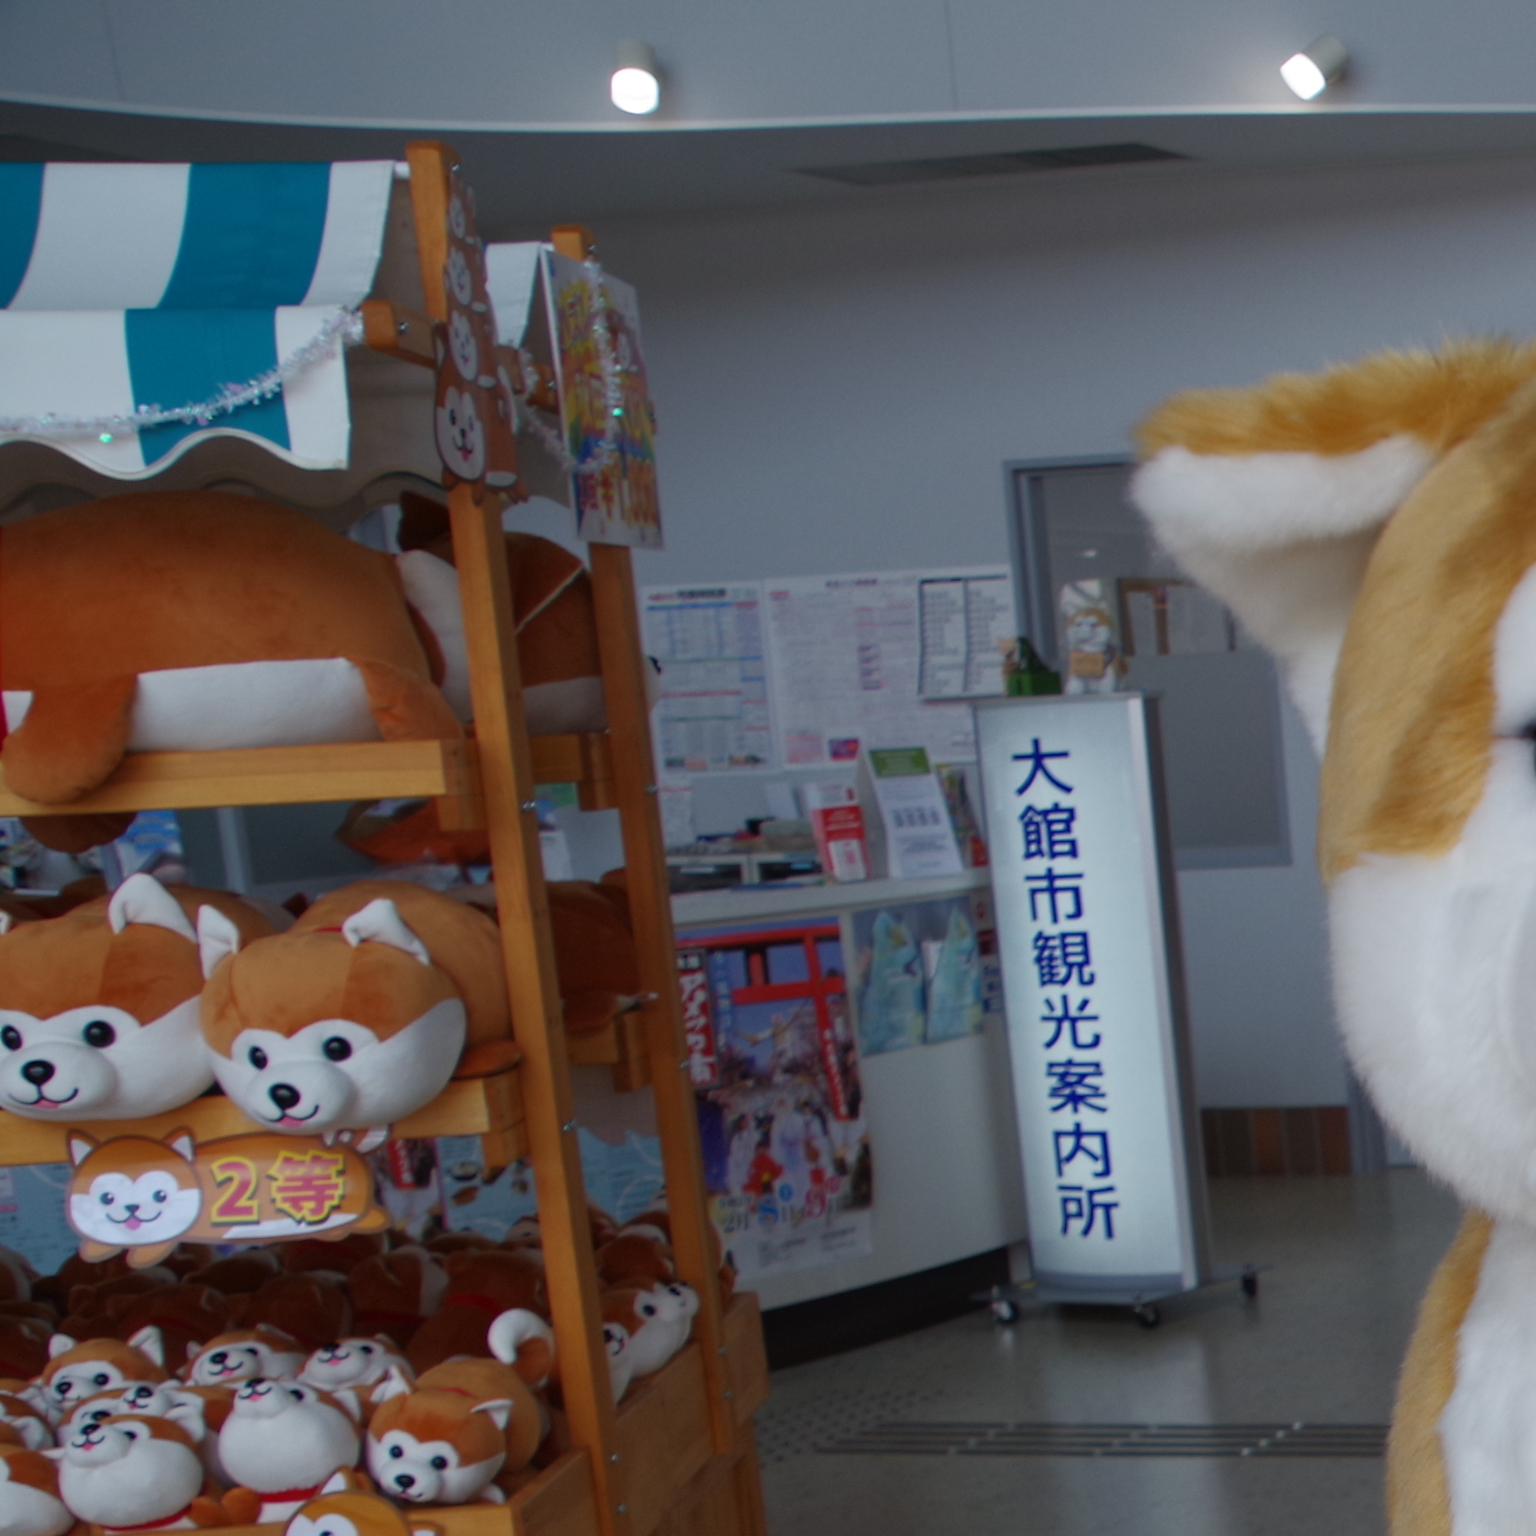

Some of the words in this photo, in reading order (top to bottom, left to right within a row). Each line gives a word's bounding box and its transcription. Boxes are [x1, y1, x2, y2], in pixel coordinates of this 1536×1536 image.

[1010, 737, 1121, 1240] 大館市観光案内所
[210, 1152, 347, 1225] 2等
